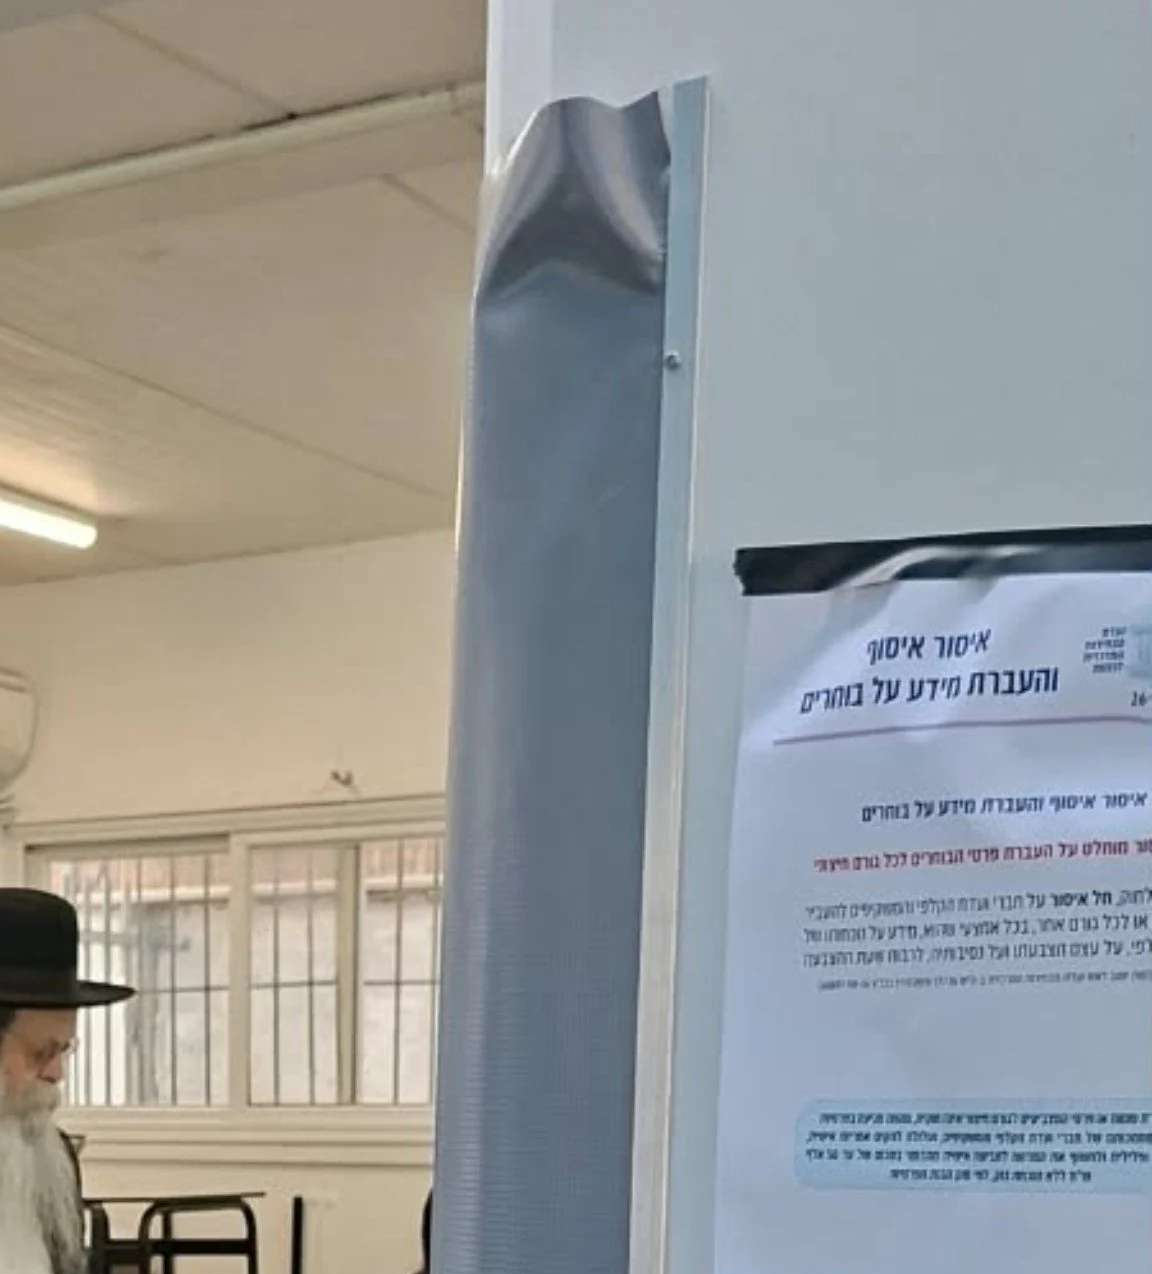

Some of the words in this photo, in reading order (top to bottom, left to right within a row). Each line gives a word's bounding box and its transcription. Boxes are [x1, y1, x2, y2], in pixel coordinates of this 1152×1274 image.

[866, 635, 925, 666] איסוף
[933, 628, 992, 659] איסור
[872, 675, 900, 706] על
[906, 676, 962, 702] מידע
[967, 667, 1059, 697] והעברת
[800, 682, 864, 714] בוחרים
[913, 800, 935, 819] על
[938, 798, 976, 817] מידע
[980, 796, 1045, 815] והעברת
[1049, 794, 1098, 814] איסוף
[1102, 791, 1148, 809] איסור
[861, 802, 911, 822] בוחרים
[910, 849, 964, 868] הבוחרים
[966, 847, 1000, 865] פרטי
[1003, 844, 1054, 862] העברת
[1056, 842, 1079, 859] על
[1082, 840, 1130, 858] מוחלט
[882, 852, 909, 869] לכל
[1049, 890, 1090, 908] איסור
[1102, 913, 1130, 931] לכל
